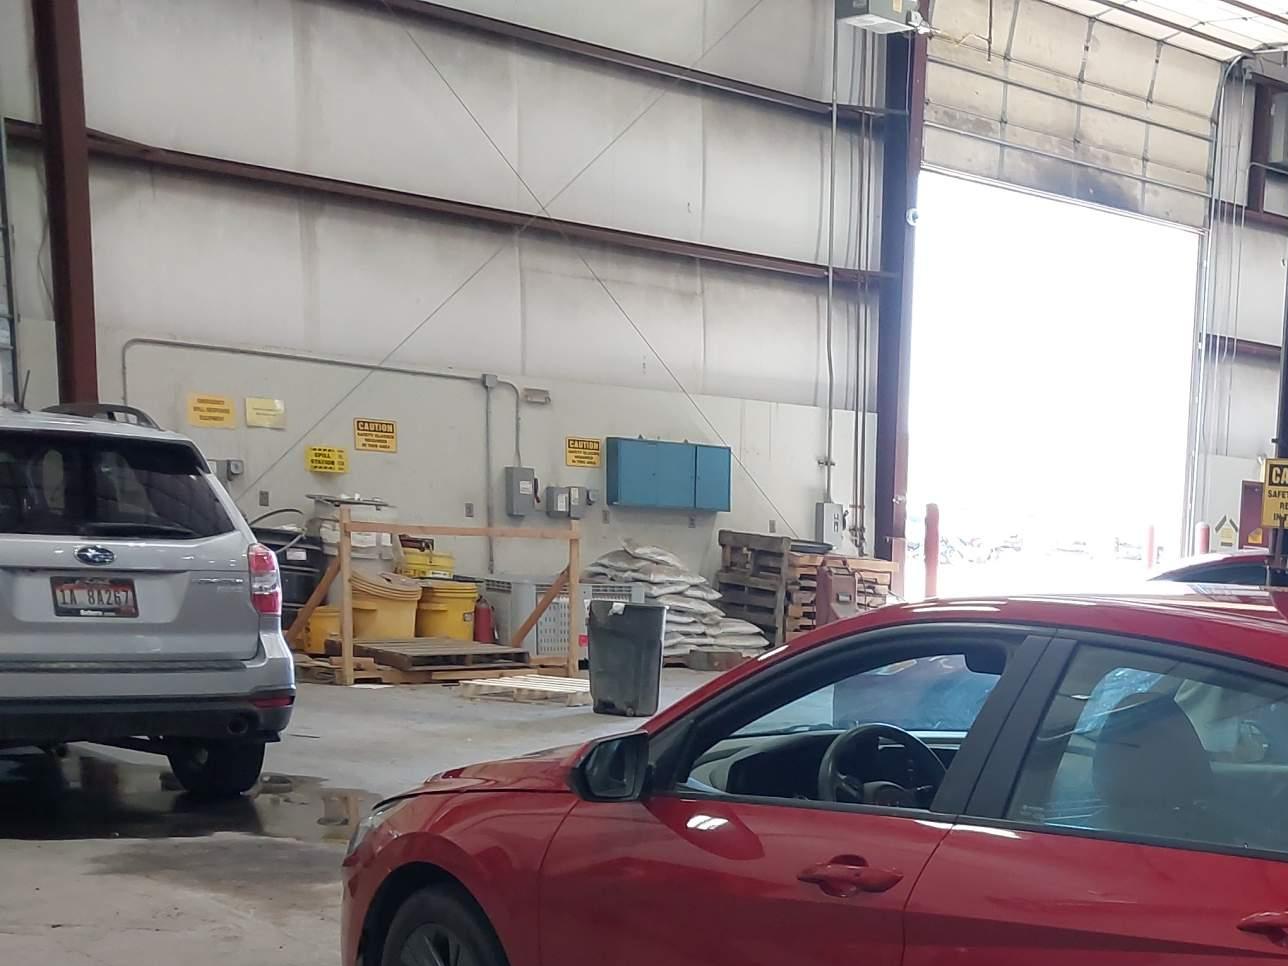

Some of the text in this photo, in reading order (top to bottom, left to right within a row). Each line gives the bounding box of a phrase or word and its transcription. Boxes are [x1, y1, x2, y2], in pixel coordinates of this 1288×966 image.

[358, 421, 393, 432] CAUTION
[569, 440, 599, 449] CAUTION
[60, 589, 129, 606] 1A 8A267
